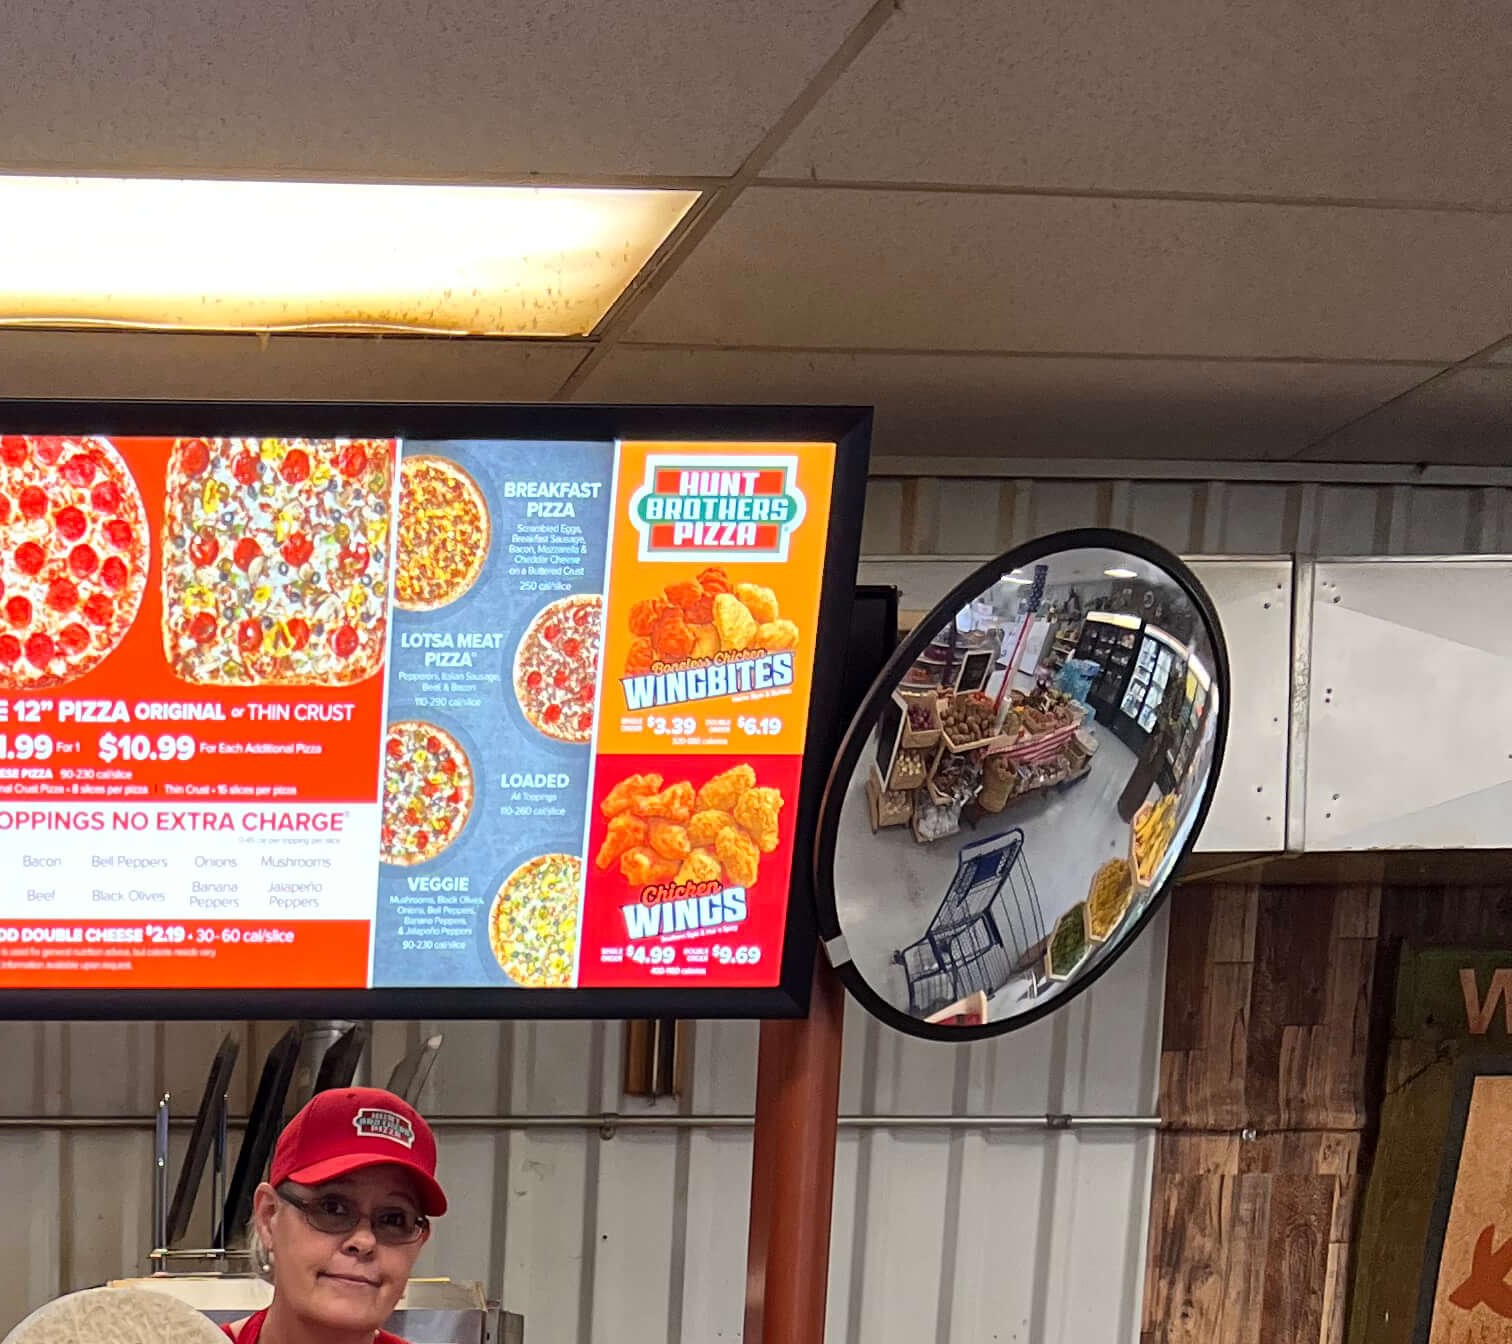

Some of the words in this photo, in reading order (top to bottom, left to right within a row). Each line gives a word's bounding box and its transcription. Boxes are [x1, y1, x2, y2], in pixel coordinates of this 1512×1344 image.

[505, 483, 601, 498] BREAKFAST
[679, 471, 760, 496] HUNT
[527, 502, 575, 517] PIZZA
[646, 498, 789, 521] BROTHERS
[673, 522, 756, 546] PIZZA
[402, 634, 453, 648] LOTSA
[456, 634, 503, 648] MEAT
[622, 653, 793, 710] WINGBITES
[58, 702, 130, 722] PIZZA
[135, 704, 225, 721] ORIGINAL
[232, 707, 245, 719] or
[249, 704, 290, 721] THIN
[295, 705, 354, 722] CRUST
[647, 716, 696, 734] $3.39
[737, 716, 781, 734] $6.19
[98, 732, 195, 763] $10.99
[501, 774, 569, 788] LOADED
[112, 812, 149, 830] NO
[156, 812, 235, 830] EXTRA
[23, 855, 62, 868] Bacon
[195, 856, 237, 869] Onions
[261, 856, 331, 869] Mushrooms
[407, 877, 469, 891] VEGGIE
[641, 881, 721, 903] Chicken
[27, 889, 55, 902] Beef
[622, 889, 746, 939] WINGS
[22, 928, 83, 942] DOUBLE
[86, 929, 143, 943] CHEESE
[146, 926, 185, 944] $2.19
[627, 946, 675, 964] $4.99
[712, 946, 760, 964] $9.69
